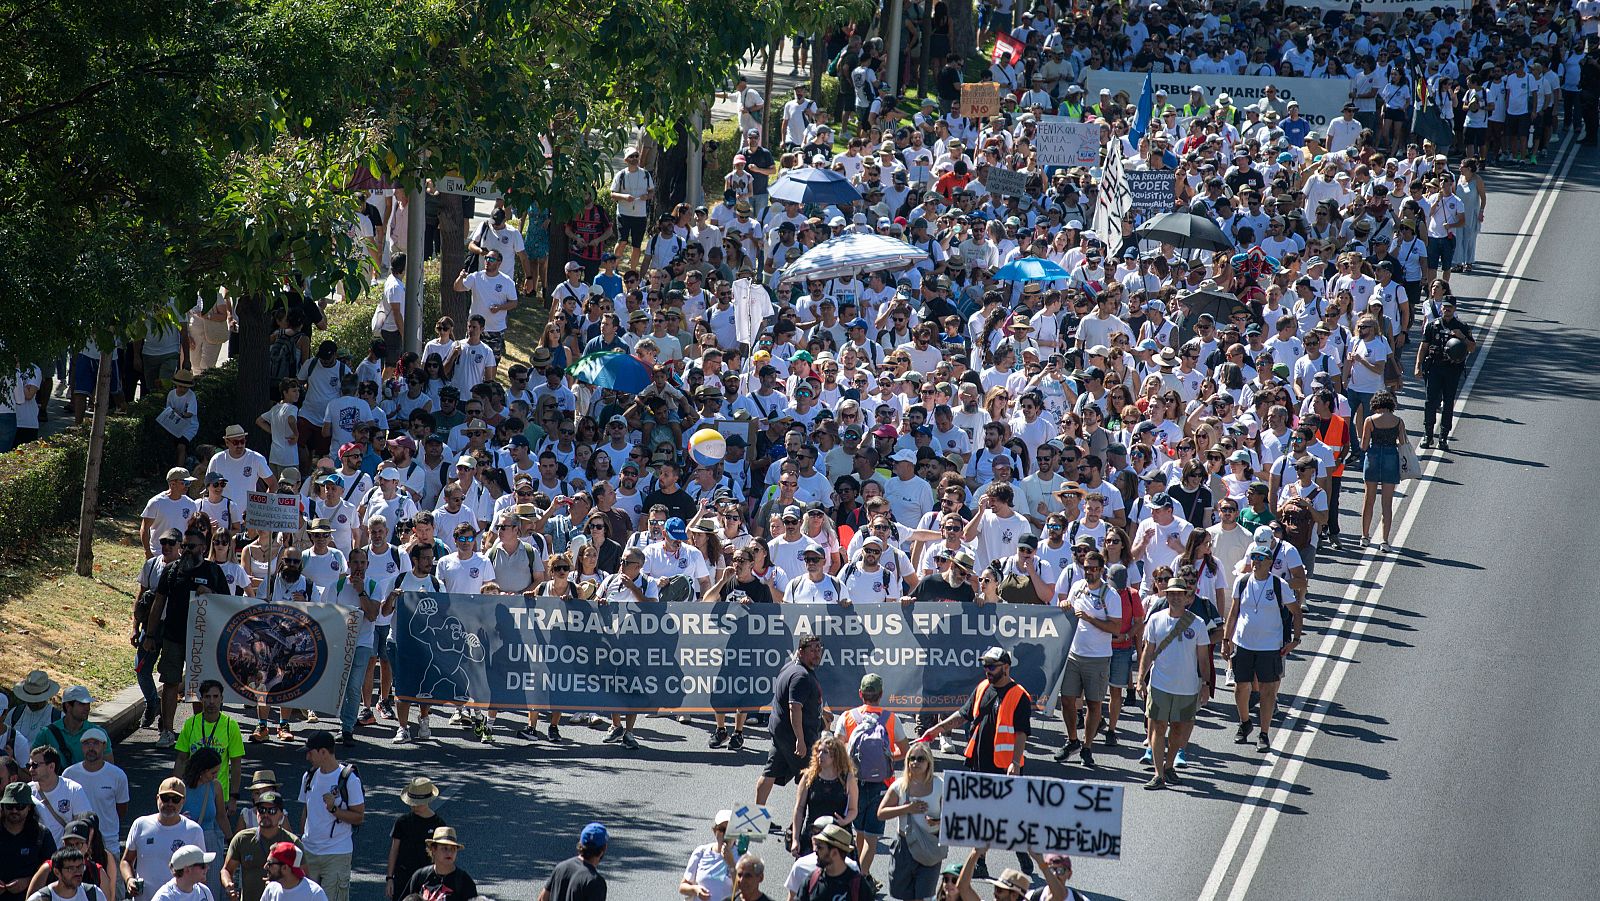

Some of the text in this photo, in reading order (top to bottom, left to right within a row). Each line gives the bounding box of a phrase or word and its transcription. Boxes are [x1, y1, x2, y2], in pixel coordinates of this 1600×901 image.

[1150, 84, 1191, 96] IRBU
[1206, 86, 1217, 96] Y
[970, 104, 989, 114] NO
[1142, 172, 1175, 181] RECUPERAR
[1132, 181, 1170, 191] PODER
[264, 604, 294, 615] AIRBUS
[509, 607, 1059, 638] TRABAJADORES DE AIRBUS EN LUCHA
[508, 643, 589, 665] UNIDOS
[595, 647, 640, 667] POR
[647, 648, 674, 667] EL
[680, 648, 781, 668] RESPETO
[820, 648, 835, 666] A
[841, 646, 1013, 668] RECUPERACI
[506, 671, 535, 691] DE
[543, 672, 659, 694] NUESTRAS
[889, 694, 971, 705] #ESTONOSEPAR
[1027, 780, 1065, 807] NO
[1074, 785, 1115, 812] SE
